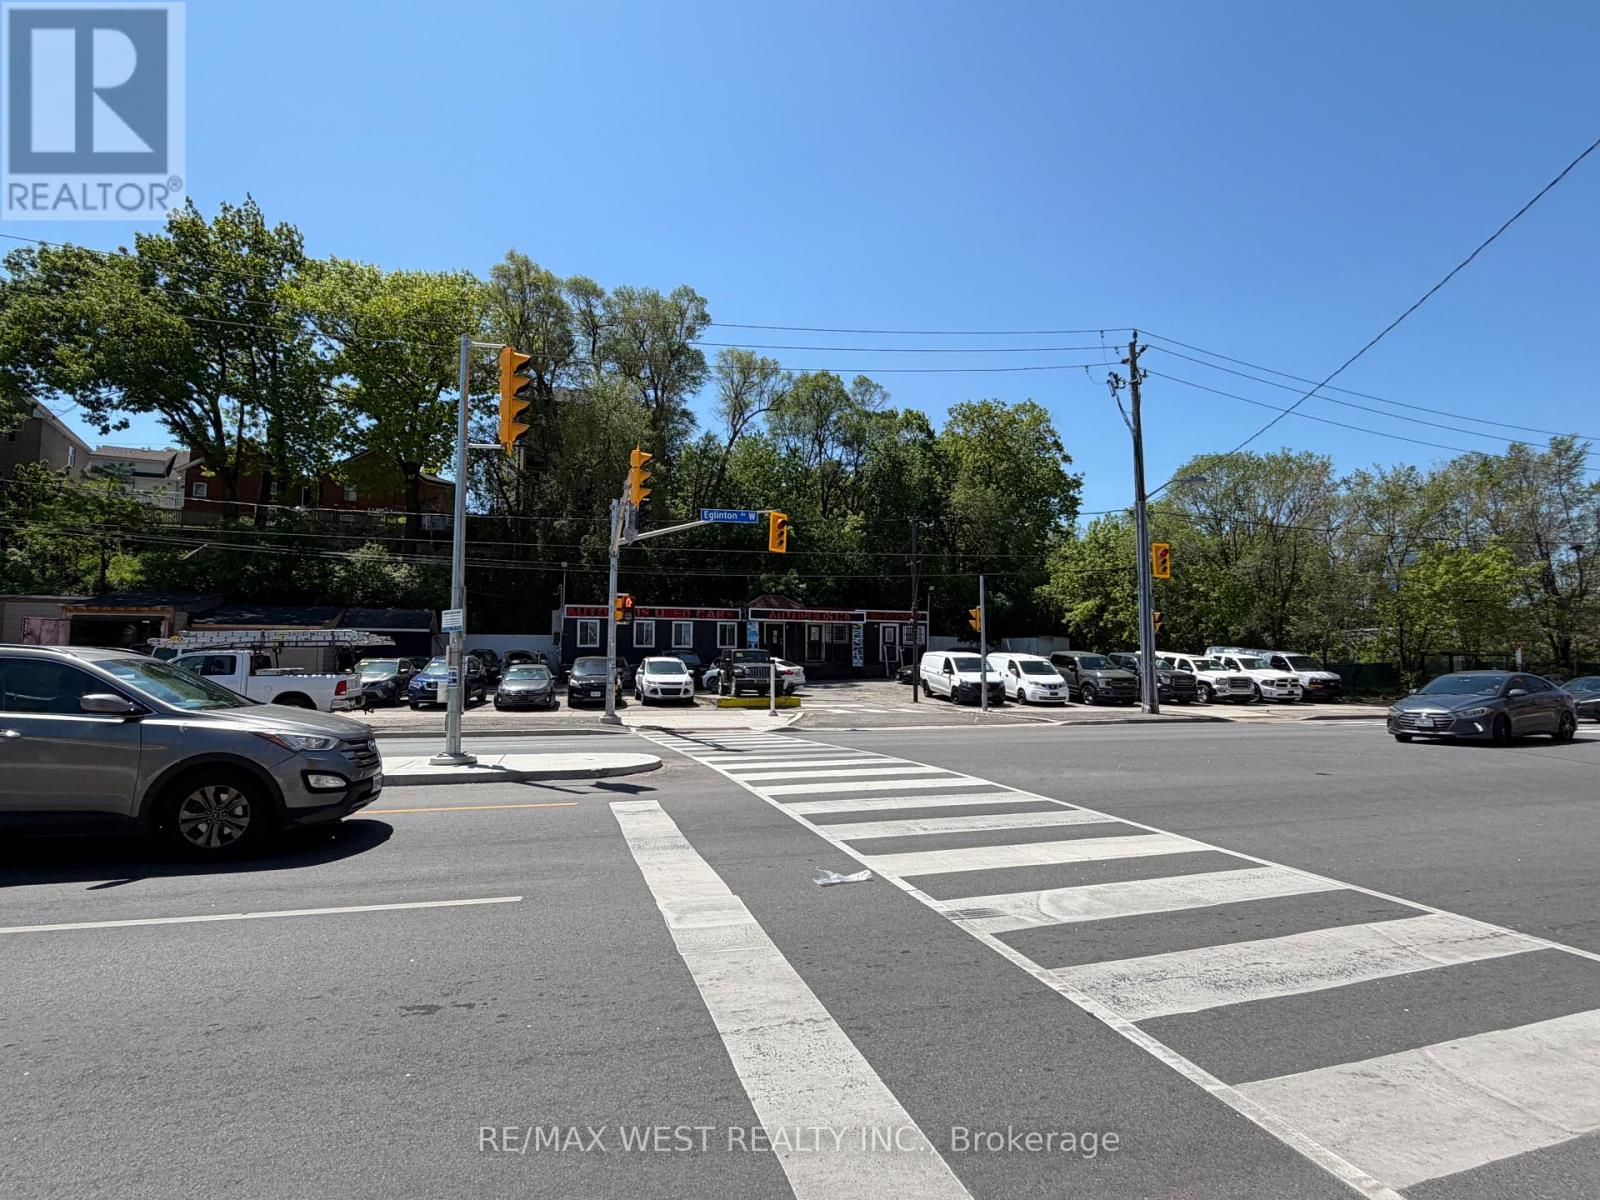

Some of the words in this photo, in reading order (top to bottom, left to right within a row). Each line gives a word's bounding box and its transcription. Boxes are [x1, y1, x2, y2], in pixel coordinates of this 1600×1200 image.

[704, 511, 737, 521] Eglinton
[748, 511, 755, 520] W
[567, 607, 649, 617] AUTOIS
[655, 608, 691, 618] USED
[696, 609, 735, 619] CARS
